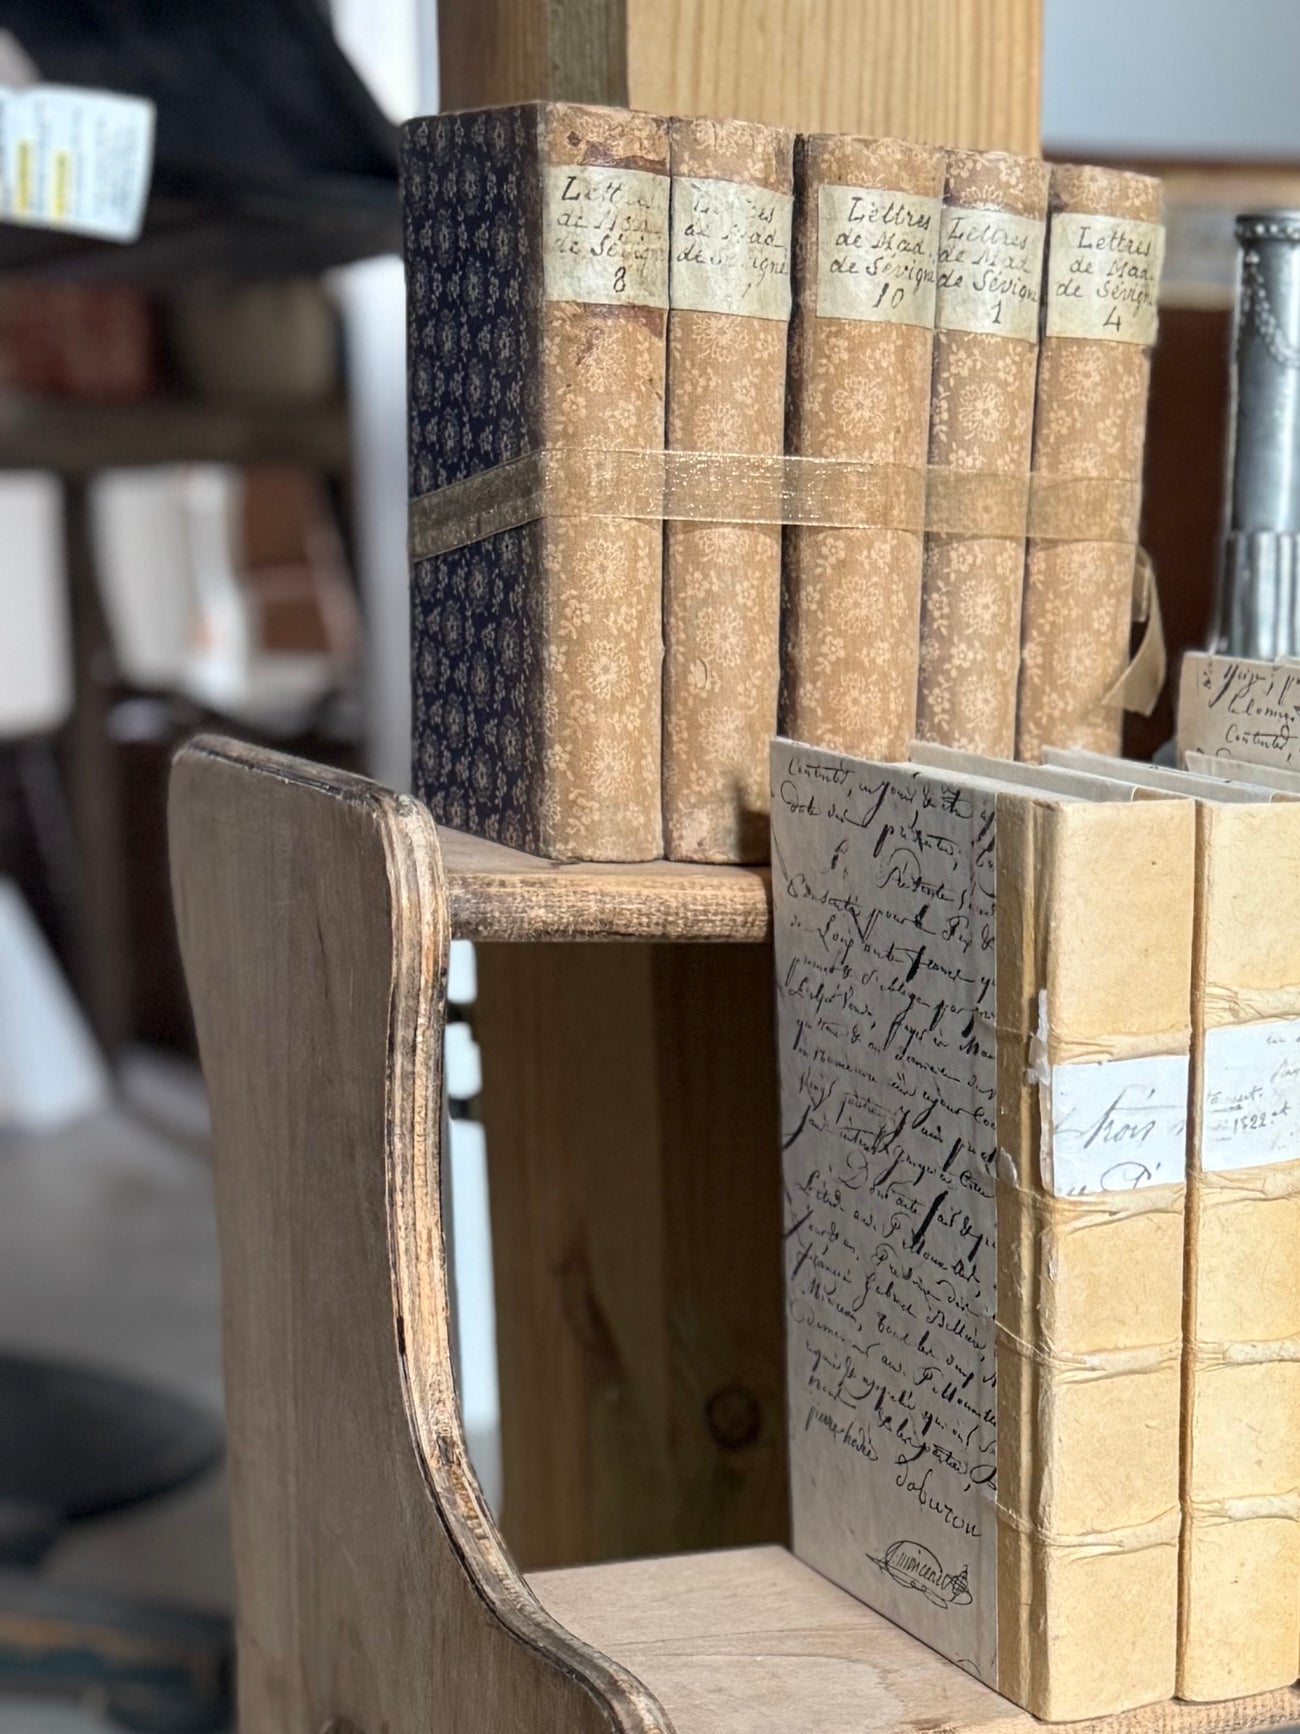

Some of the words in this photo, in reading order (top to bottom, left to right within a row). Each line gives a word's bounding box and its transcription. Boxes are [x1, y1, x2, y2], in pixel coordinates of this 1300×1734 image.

[847, 196, 931, 231] Lettres
[835, 228, 863, 249] de
[948, 216, 1028, 250] Lettres
[1077, 226, 1152, 257] Lettres
[830, 255, 860, 274] de
[938, 242, 966, 264] de
[1069, 255, 1095, 275] de
[613, 266, 626, 293] 8
[936, 268, 964, 289] de
[1056, 278, 1085, 298] de
[990, 299, 1002, 325] 1
[1103, 305, 1122, 333] 4
